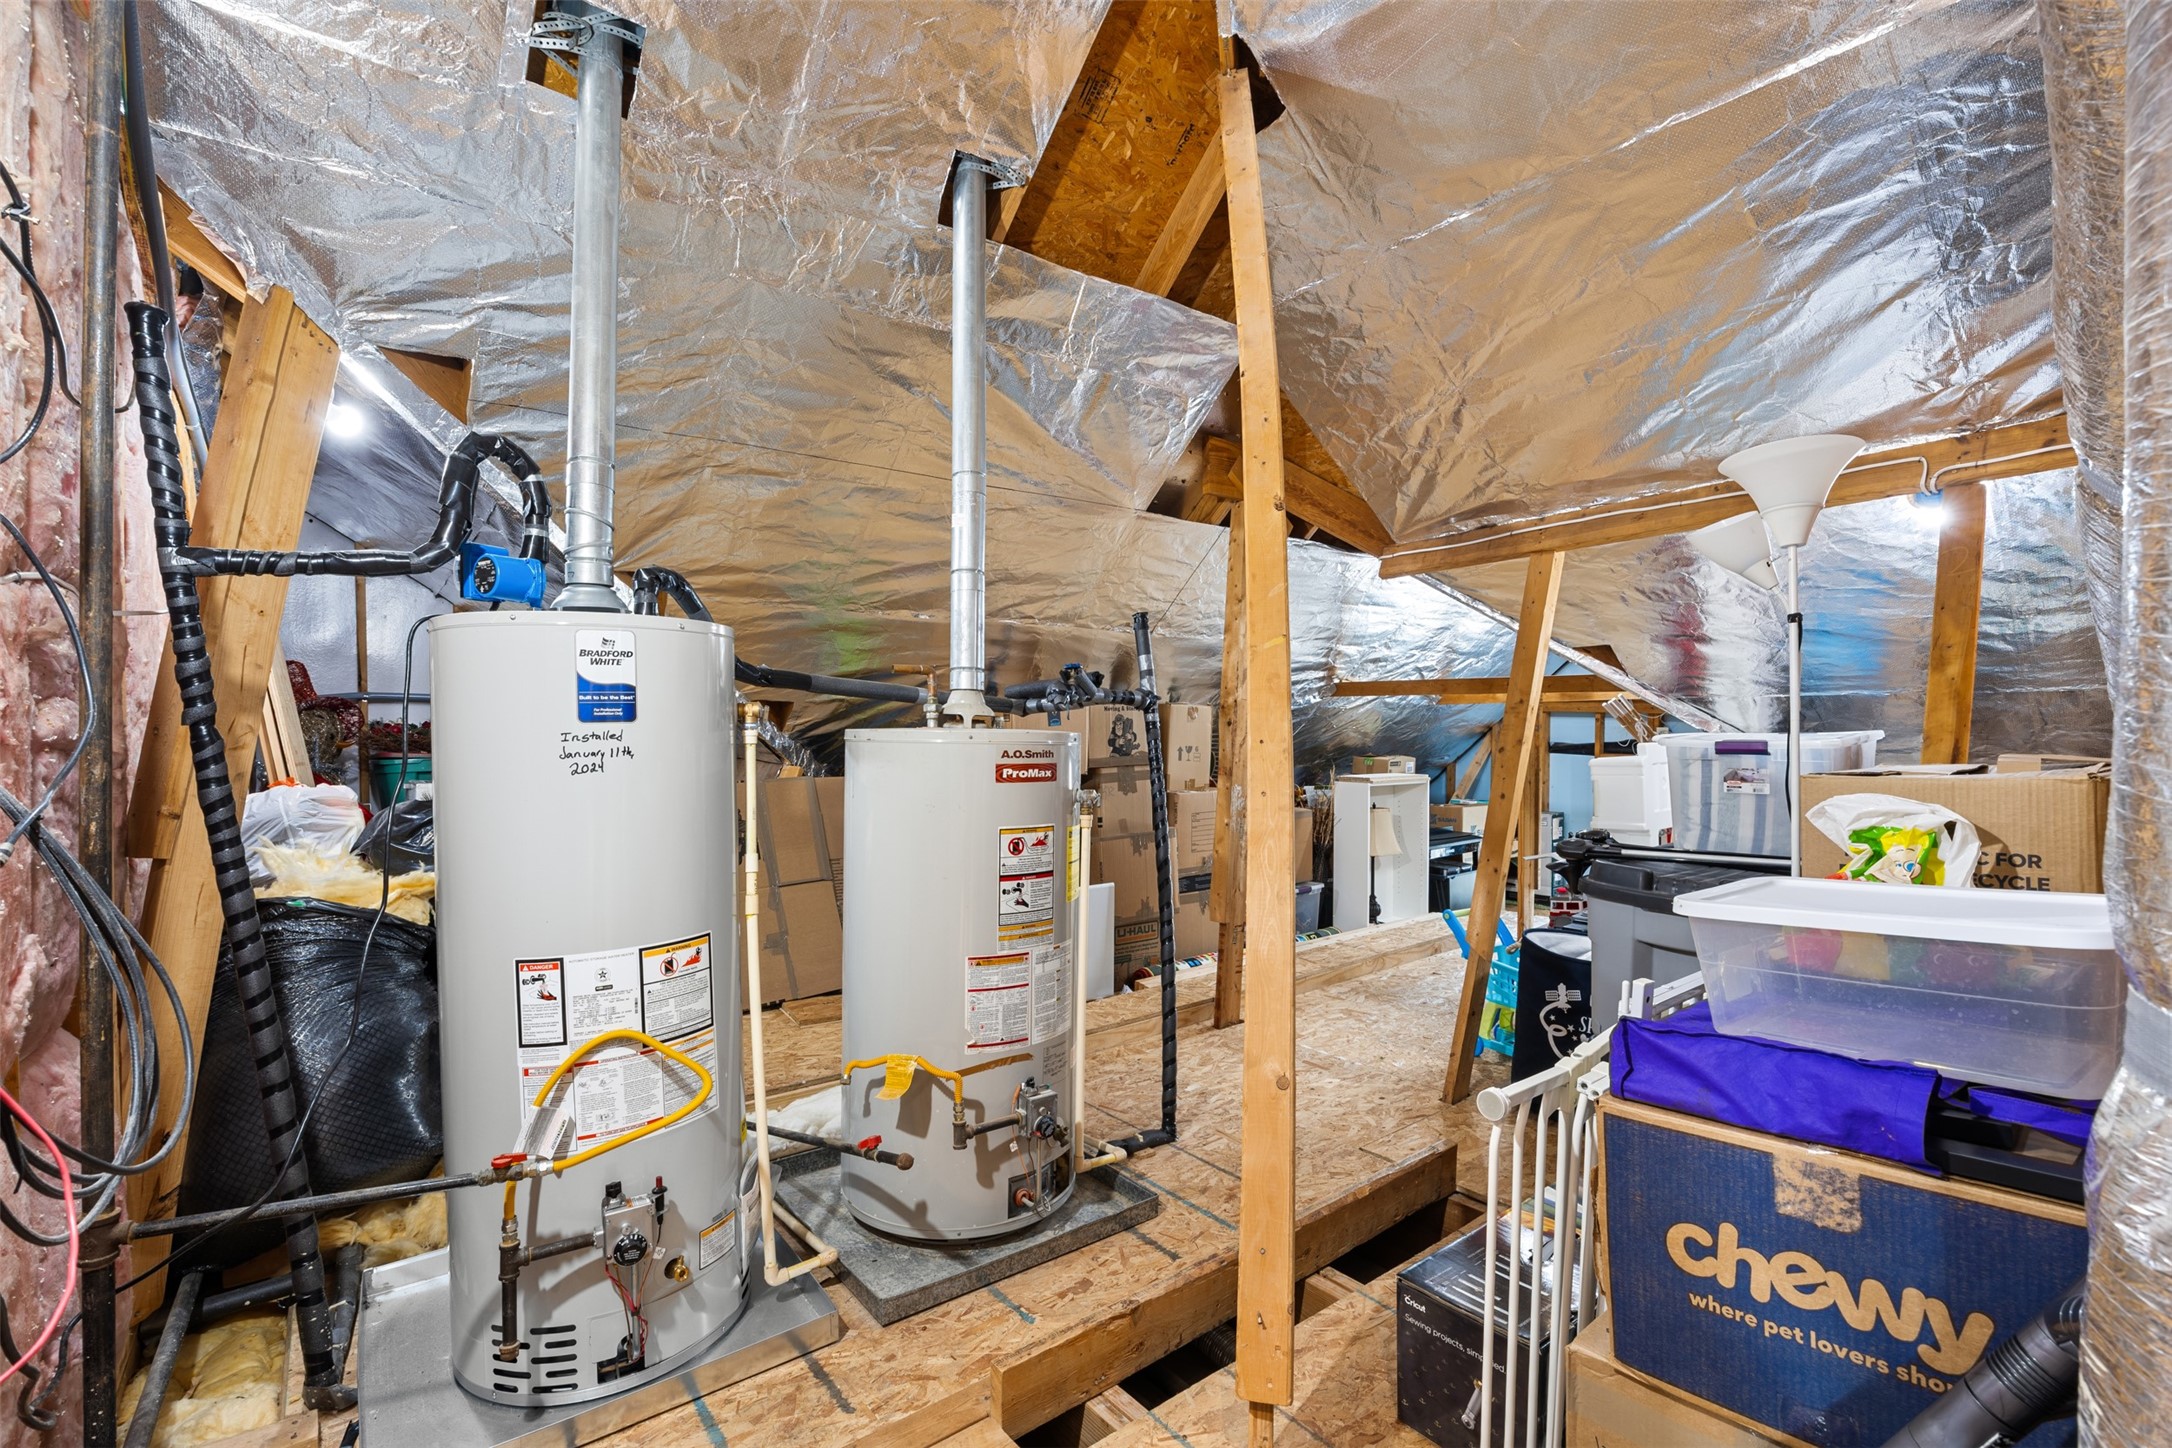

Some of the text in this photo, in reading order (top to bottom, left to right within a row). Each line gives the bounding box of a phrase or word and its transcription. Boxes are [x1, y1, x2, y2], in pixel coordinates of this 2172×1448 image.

[579, 649, 633, 658] BRADFORD
[590, 657, 622, 666] WHITE
[560, 729, 623, 743] Installed
[559, 746, 605, 762] January
[1001, 750, 1054, 758] A.O.Smith
[569, 761, 604, 776] 2024
[1002, 768, 1052, 778] ProMax
[1995, 852, 2042, 869] FOR
[1116, 924, 1156, 938] U-HAUL
[1404, 1293, 1426, 1314] Cricut
[1666, 1222, 1995, 1376] chewy
[1404, 1313, 1431, 1335] Sewing
[1432, 1328, 1465, 1353] projects,
[1689, 1291, 1953, 1394] where pet lovers sho
